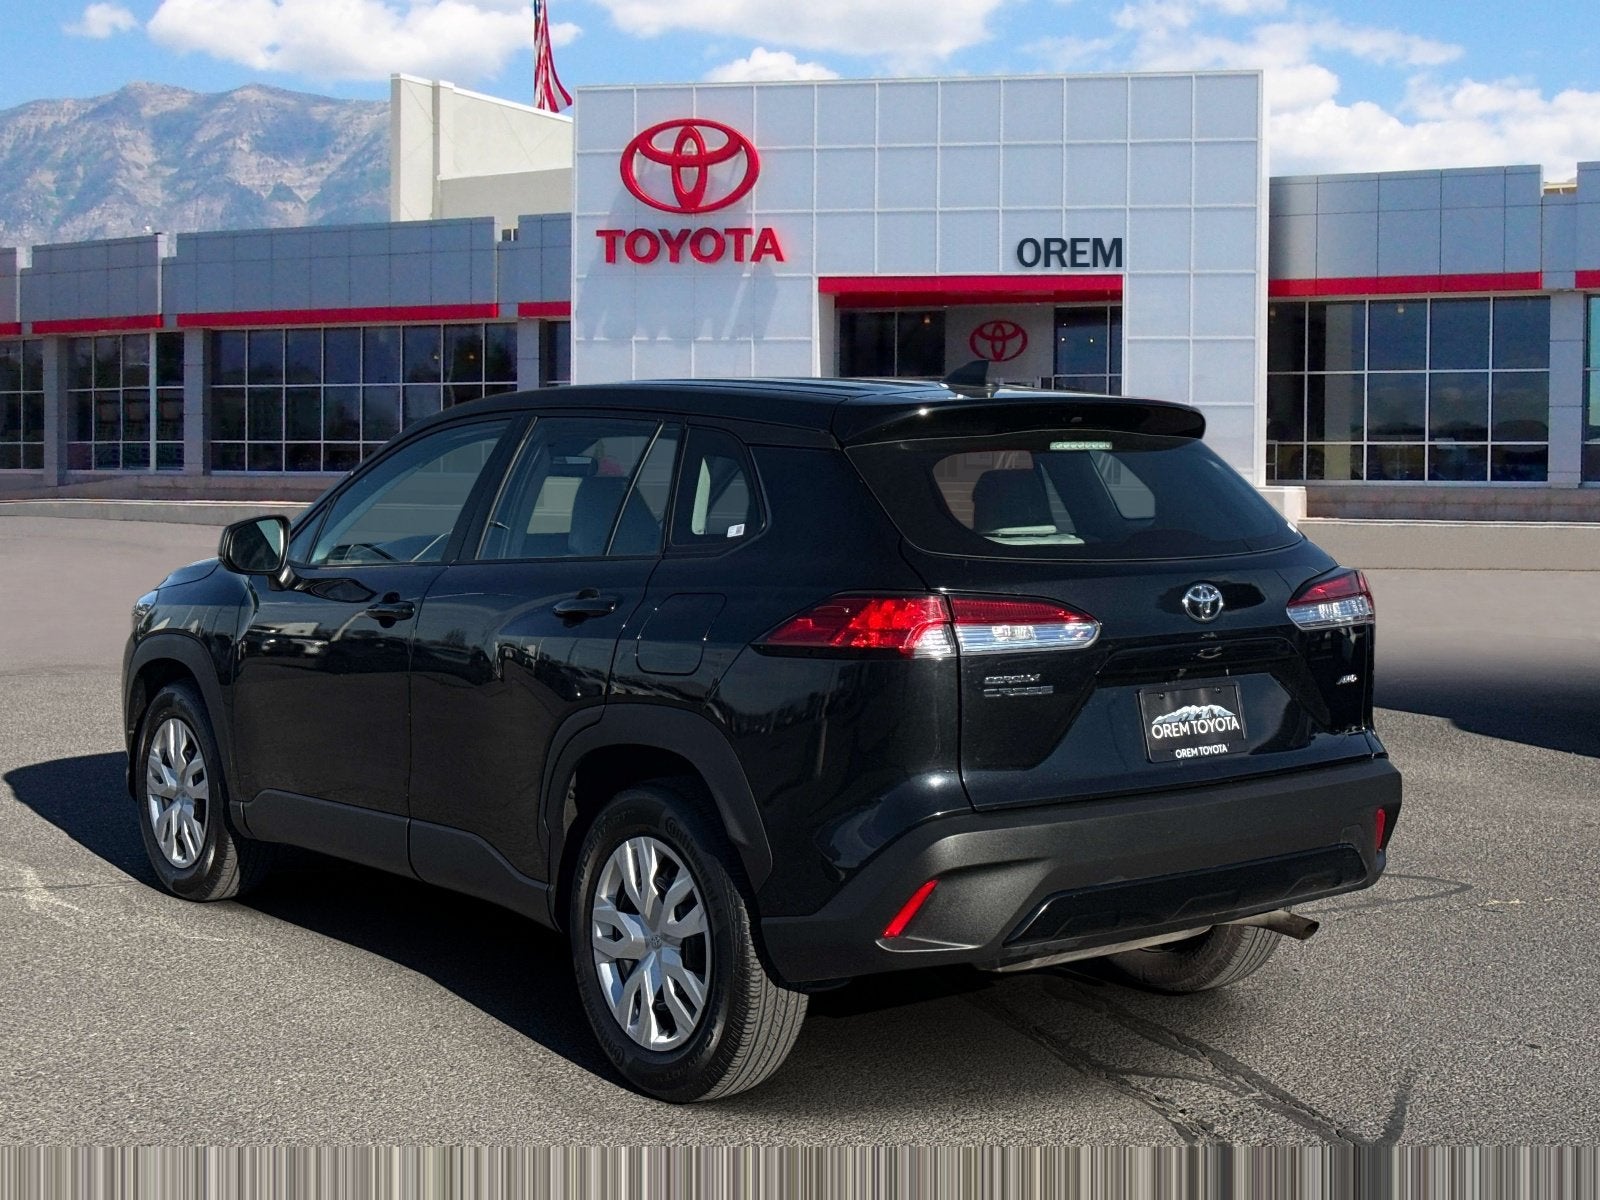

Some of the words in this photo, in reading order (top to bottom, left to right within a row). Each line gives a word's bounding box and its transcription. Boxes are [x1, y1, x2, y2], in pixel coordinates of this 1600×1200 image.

[596, 227, 785, 264] TOYOTA
[1017, 237, 1123, 268] OREM
[1151, 721, 1191, 739] OREM
[1190, 716, 1240, 735] TOYOTA
[1175, 746, 1198, 759] OREM
[1199, 743, 1228, 756] TOYOTA
